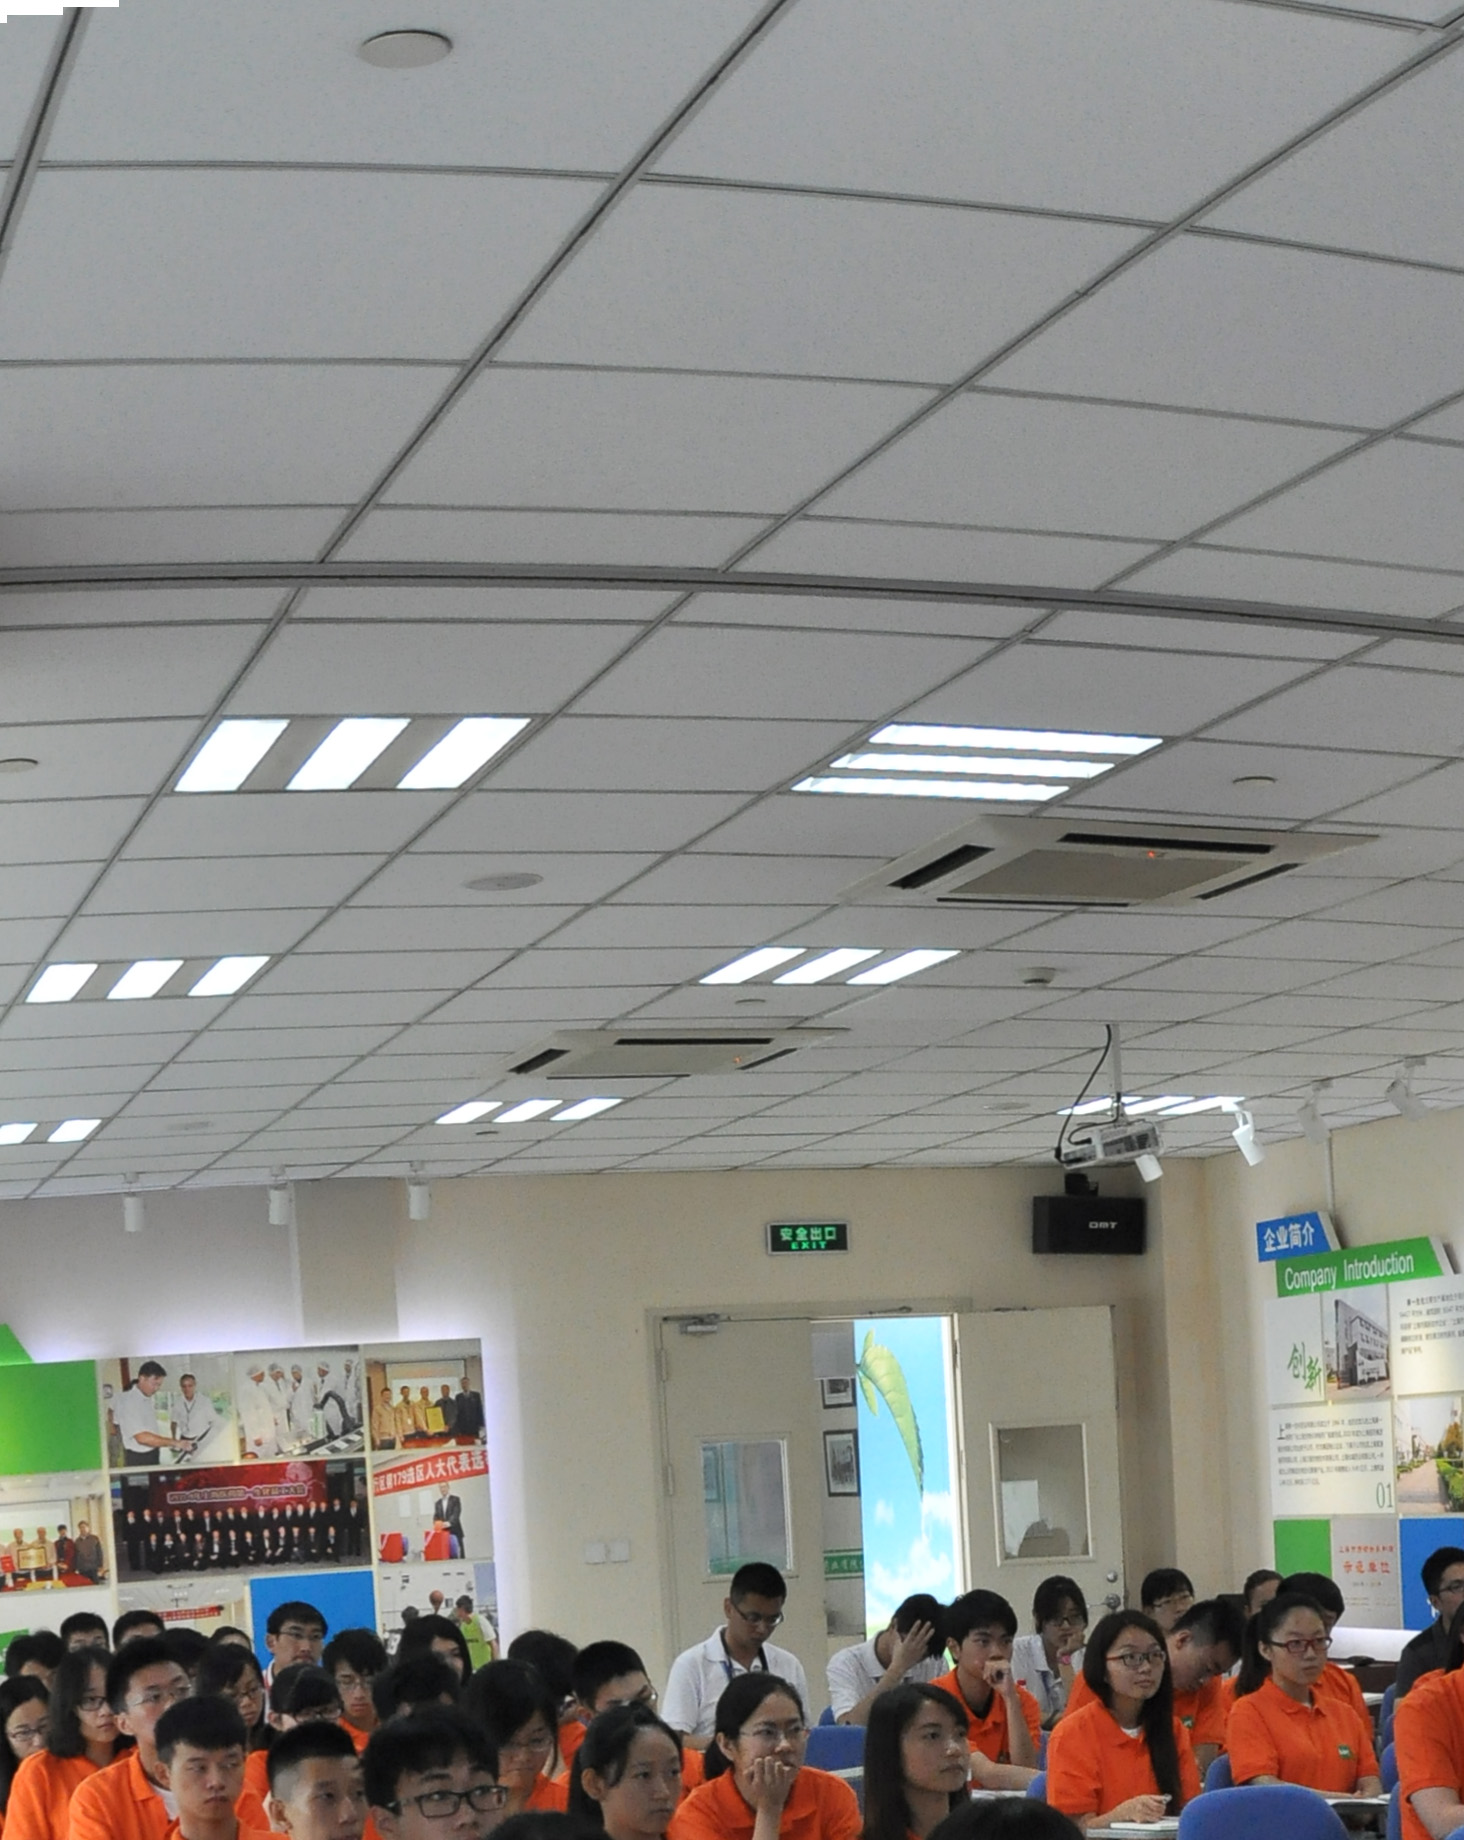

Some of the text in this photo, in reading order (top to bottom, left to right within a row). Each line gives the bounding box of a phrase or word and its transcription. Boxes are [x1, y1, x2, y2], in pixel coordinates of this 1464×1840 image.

[780, 1227, 837, 1241] 安全出口
[791, 1241, 827, 1250] EXIT
[1263, 1221, 1315, 1252] 企业简介
[1284, 1251, 1414, 1292] Company Introduction
[1287, 1342, 1322, 1397] 创新
[1376, 1482, 1393, 1508] 01
